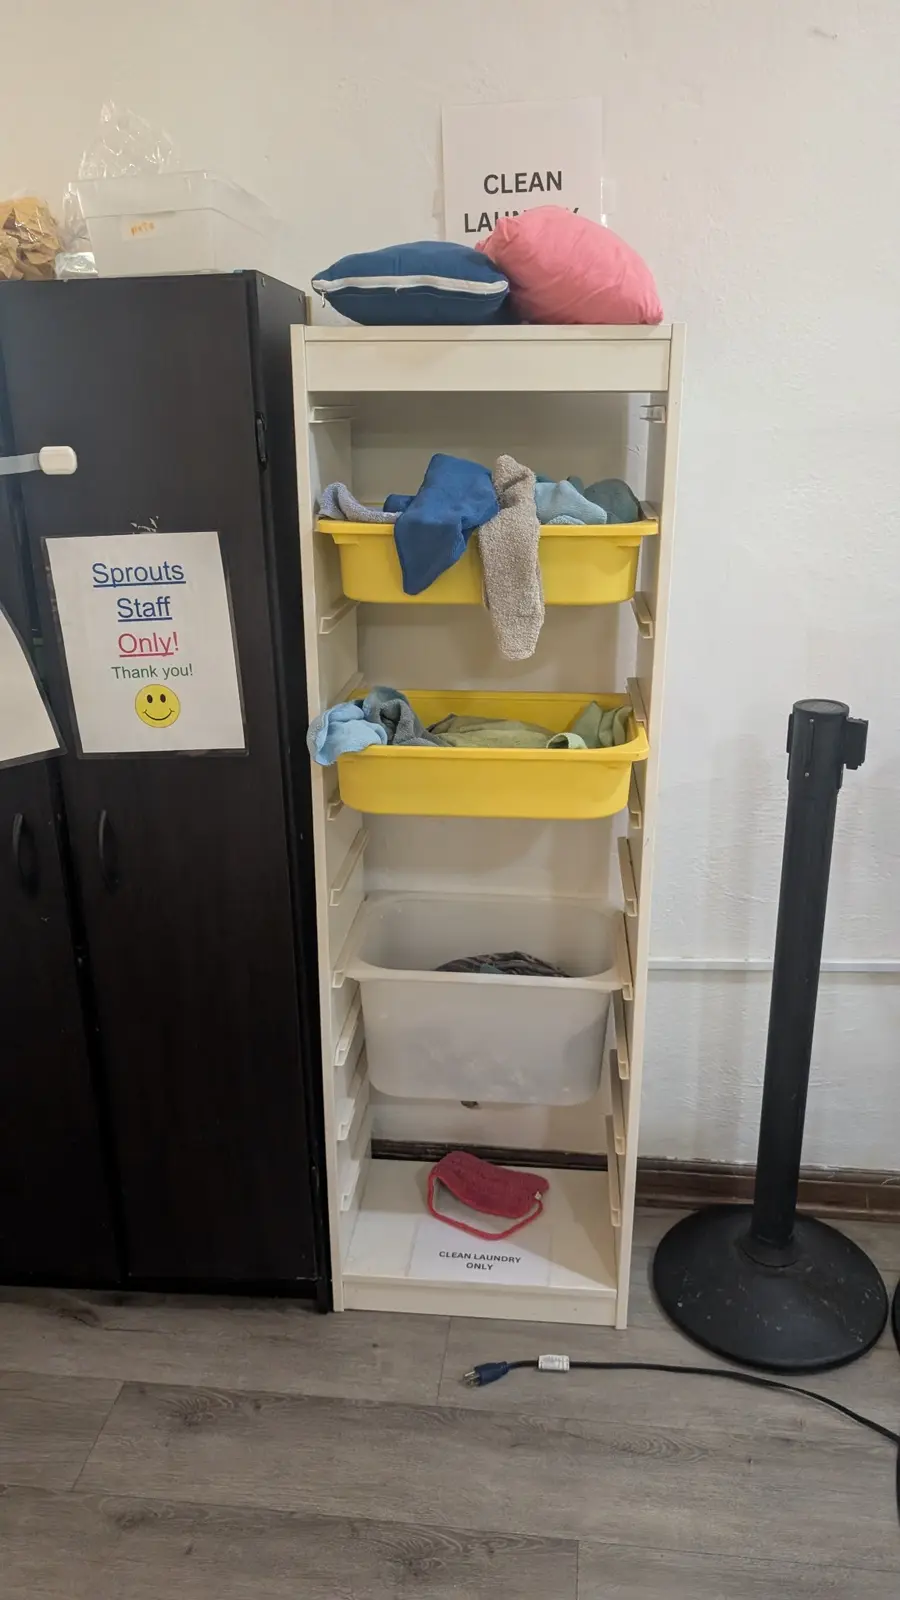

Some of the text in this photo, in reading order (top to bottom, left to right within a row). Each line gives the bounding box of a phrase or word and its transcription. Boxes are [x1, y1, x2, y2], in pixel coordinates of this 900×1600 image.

[483, 170, 563, 195] CLEAN
[92, 561, 186, 588] Sprouts
[117, 596, 172, 622] Staff
[118, 631, 179, 657] Only!
[111, 663, 194, 680] Thank you!
[438, 1250, 522, 1264] CLEAN LAUNDRY
[466, 1262, 494, 1271] ONLY
